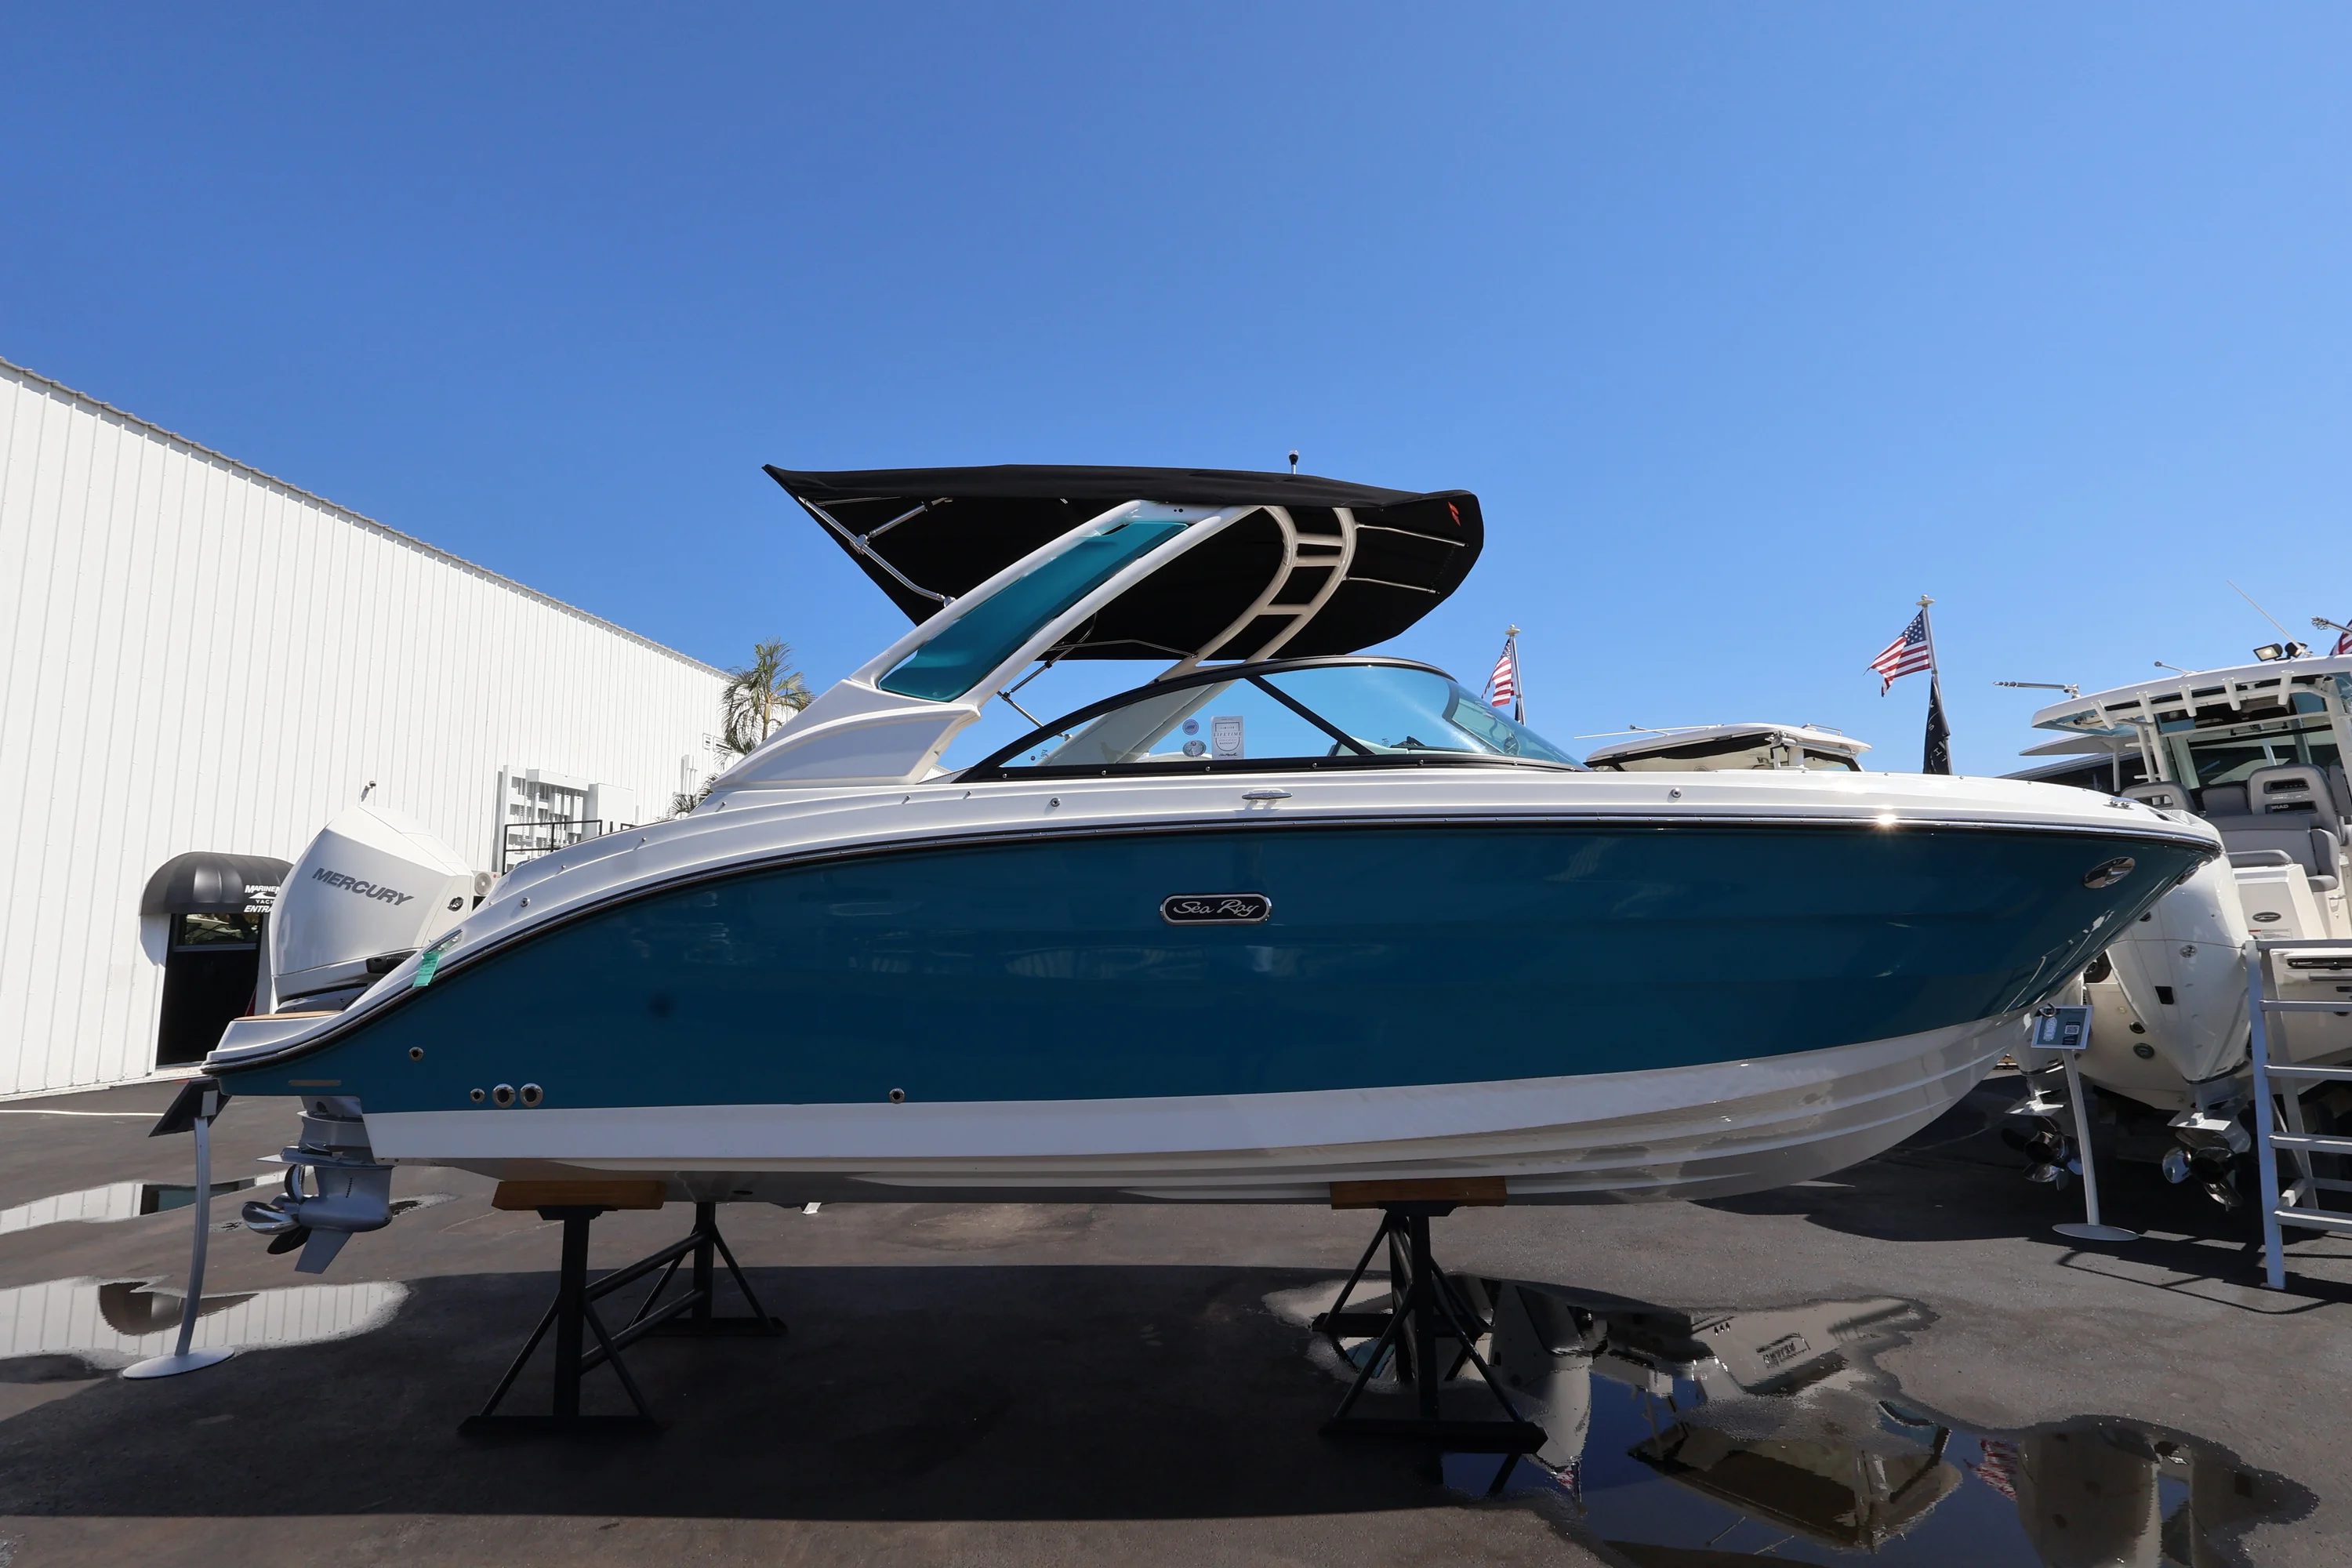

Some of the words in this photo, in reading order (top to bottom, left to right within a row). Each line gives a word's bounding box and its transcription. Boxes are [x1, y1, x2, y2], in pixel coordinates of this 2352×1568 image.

[312, 867, 415, 906] MERCURY
[1173, 901, 1214, 914] Sea
[1217, 899, 1259, 917] Ray
